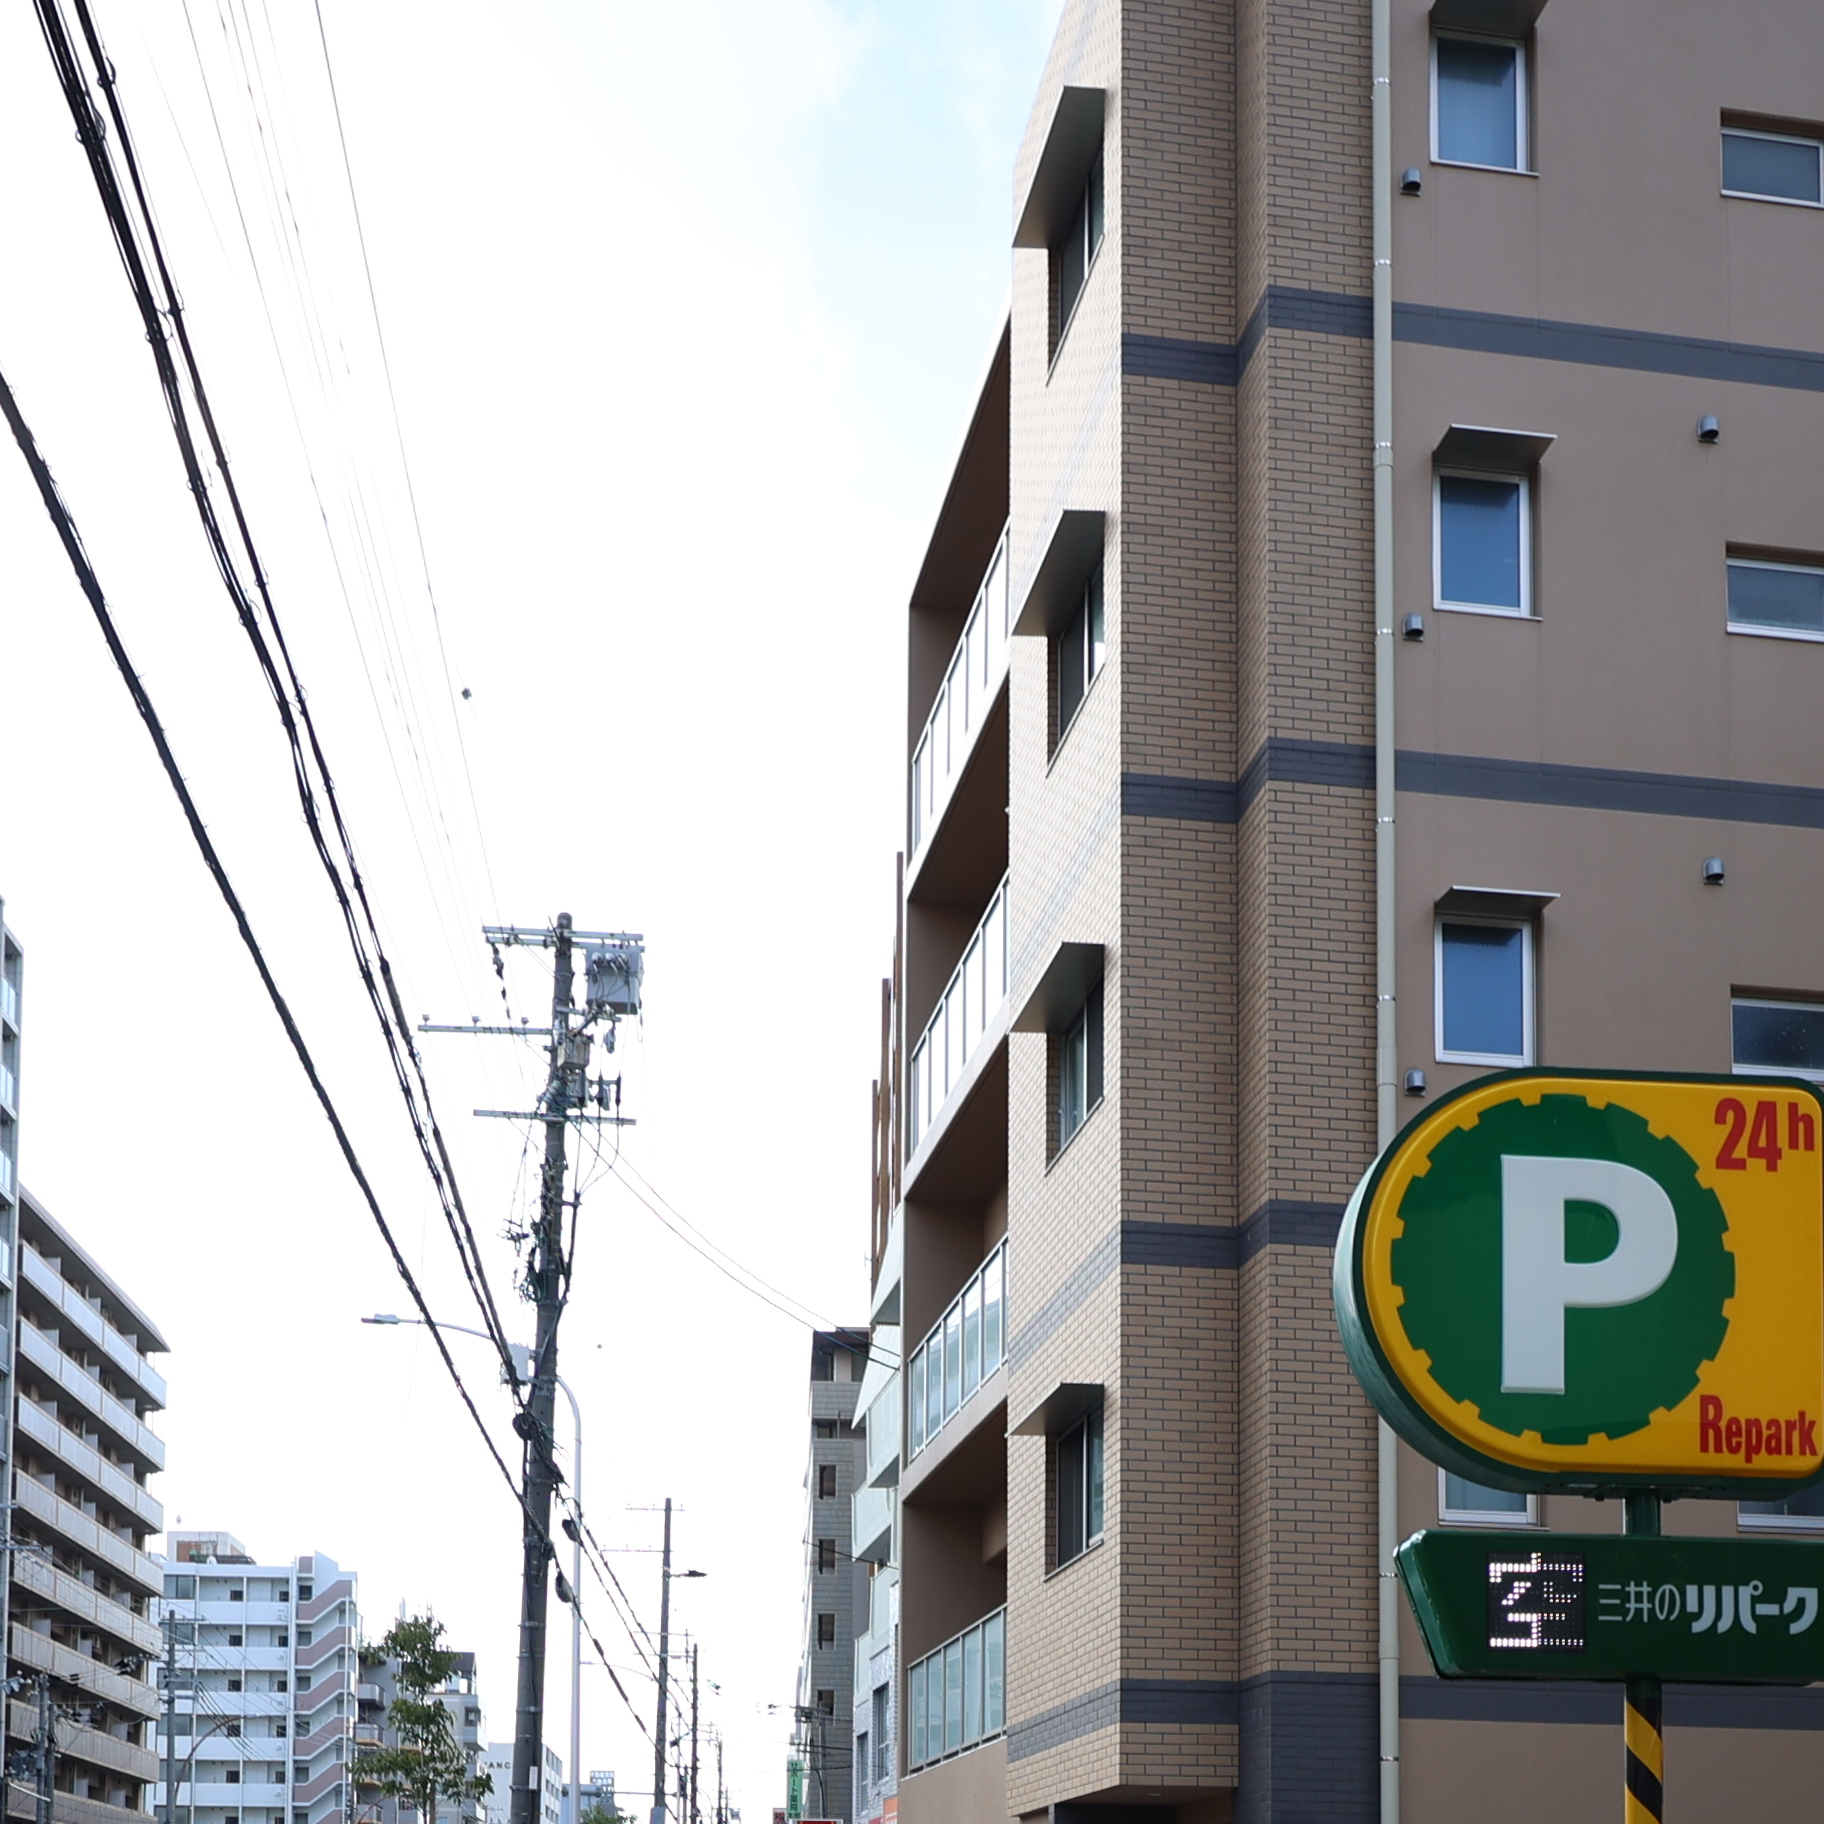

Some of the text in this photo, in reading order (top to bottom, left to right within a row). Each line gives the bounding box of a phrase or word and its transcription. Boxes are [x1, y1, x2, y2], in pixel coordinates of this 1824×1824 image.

[1499, 1153, 1679, 1395] P
[1699, 1394, 1818, 1464] Repark
[1597, 1579, 1819, 1635] 三井のリパーク
